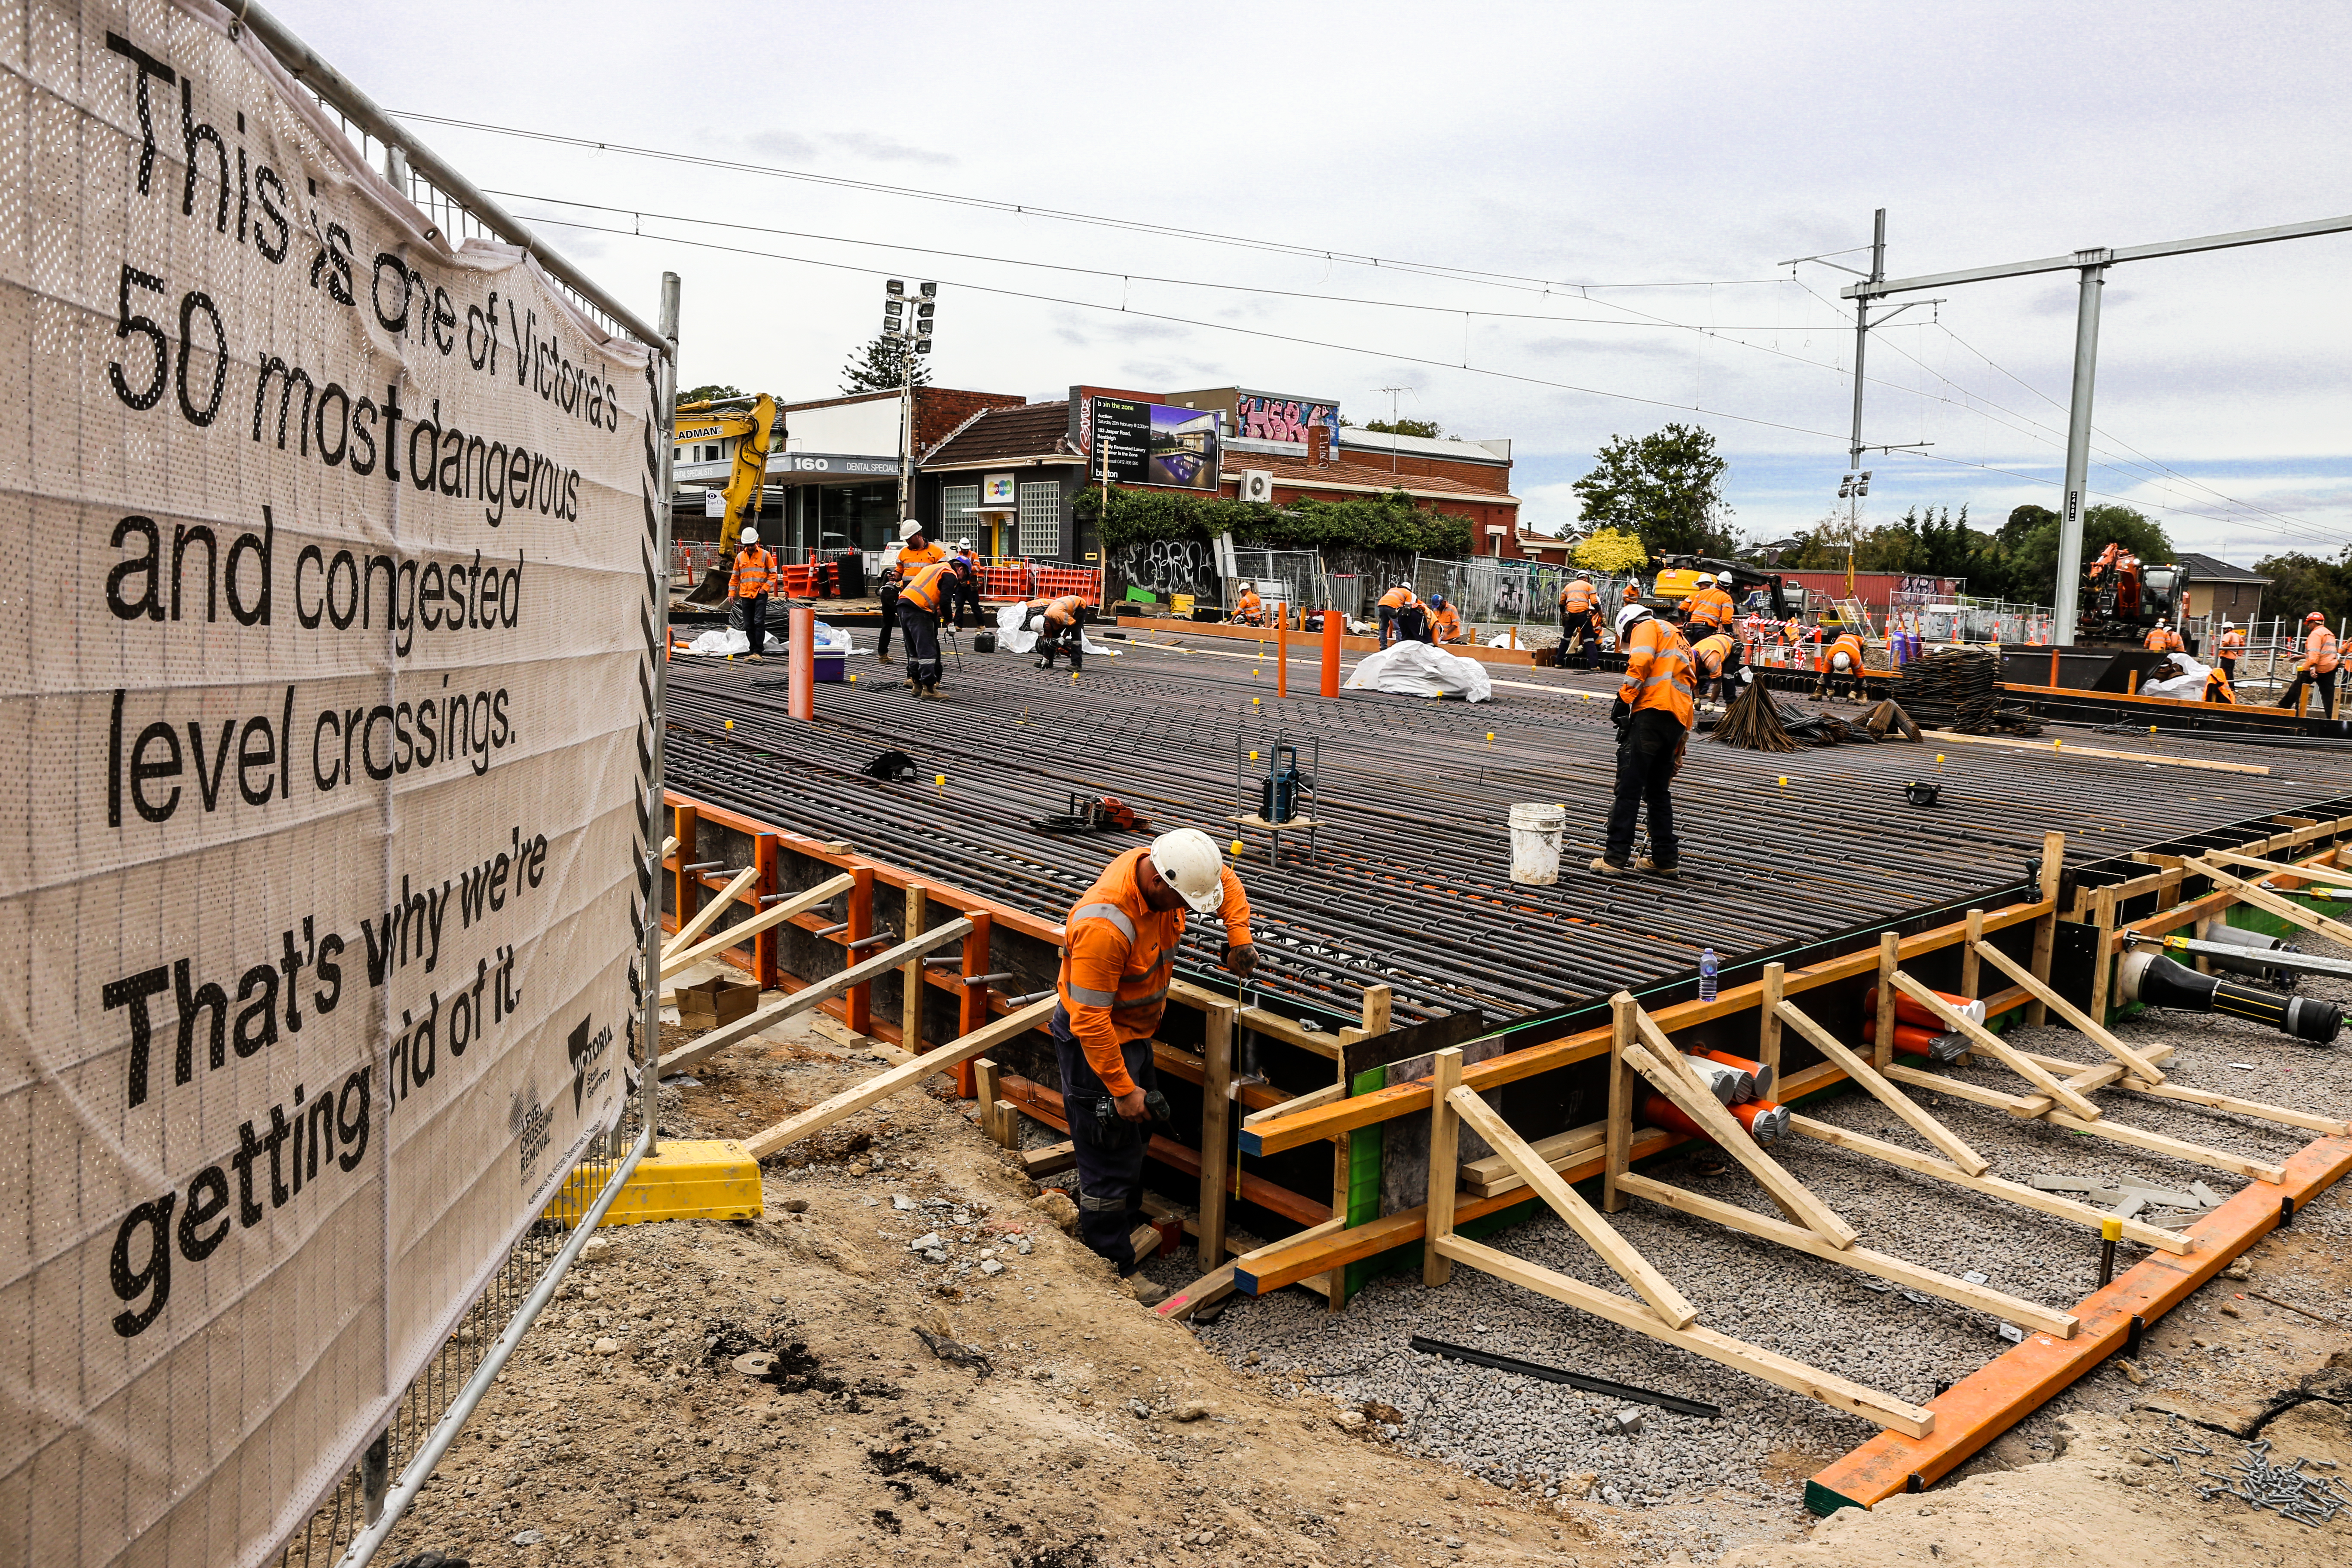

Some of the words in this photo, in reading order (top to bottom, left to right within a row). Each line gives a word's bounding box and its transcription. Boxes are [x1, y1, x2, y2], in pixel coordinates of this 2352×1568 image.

[106, 30, 290, 264] This
[309, 177, 356, 307] is
[372, 252, 456, 356] one
[467, 291, 499, 375] of
[508, 298, 617, 433] Victoria's
[108, 263, 228, 428] 50
[253, 351, 402, 482] most
[410, 398, 580, 528] dangerous
[687, 467, 713, 478] SPECIALISTS
[795, 457, 829, 471] 160
[847, 462, 870, 471] DENTAL
[1096, 469, 1118, 478] buton
[105, 505, 273, 627] and
[296, 549, 524, 658] congested
[108, 685, 295, 828] level
[313, 674, 516, 792] crossings.
[102, 915, 344, 1109] That's
[361, 874, 451, 990] why
[461, 826, 548, 930] we're
[573, 1023, 612, 1078] VICTORIA
[521, 1106, 554, 1154] CROSSING
[522, 1102, 543, 1135] LEVEL
[111, 1064, 371, 1338] getting
[389, 991, 439, 1114] rid
[450, 953, 486, 1057] of
[521, 1128, 551, 1174] REMOVAL
[521, 1162, 537, 1189] PROJECT
